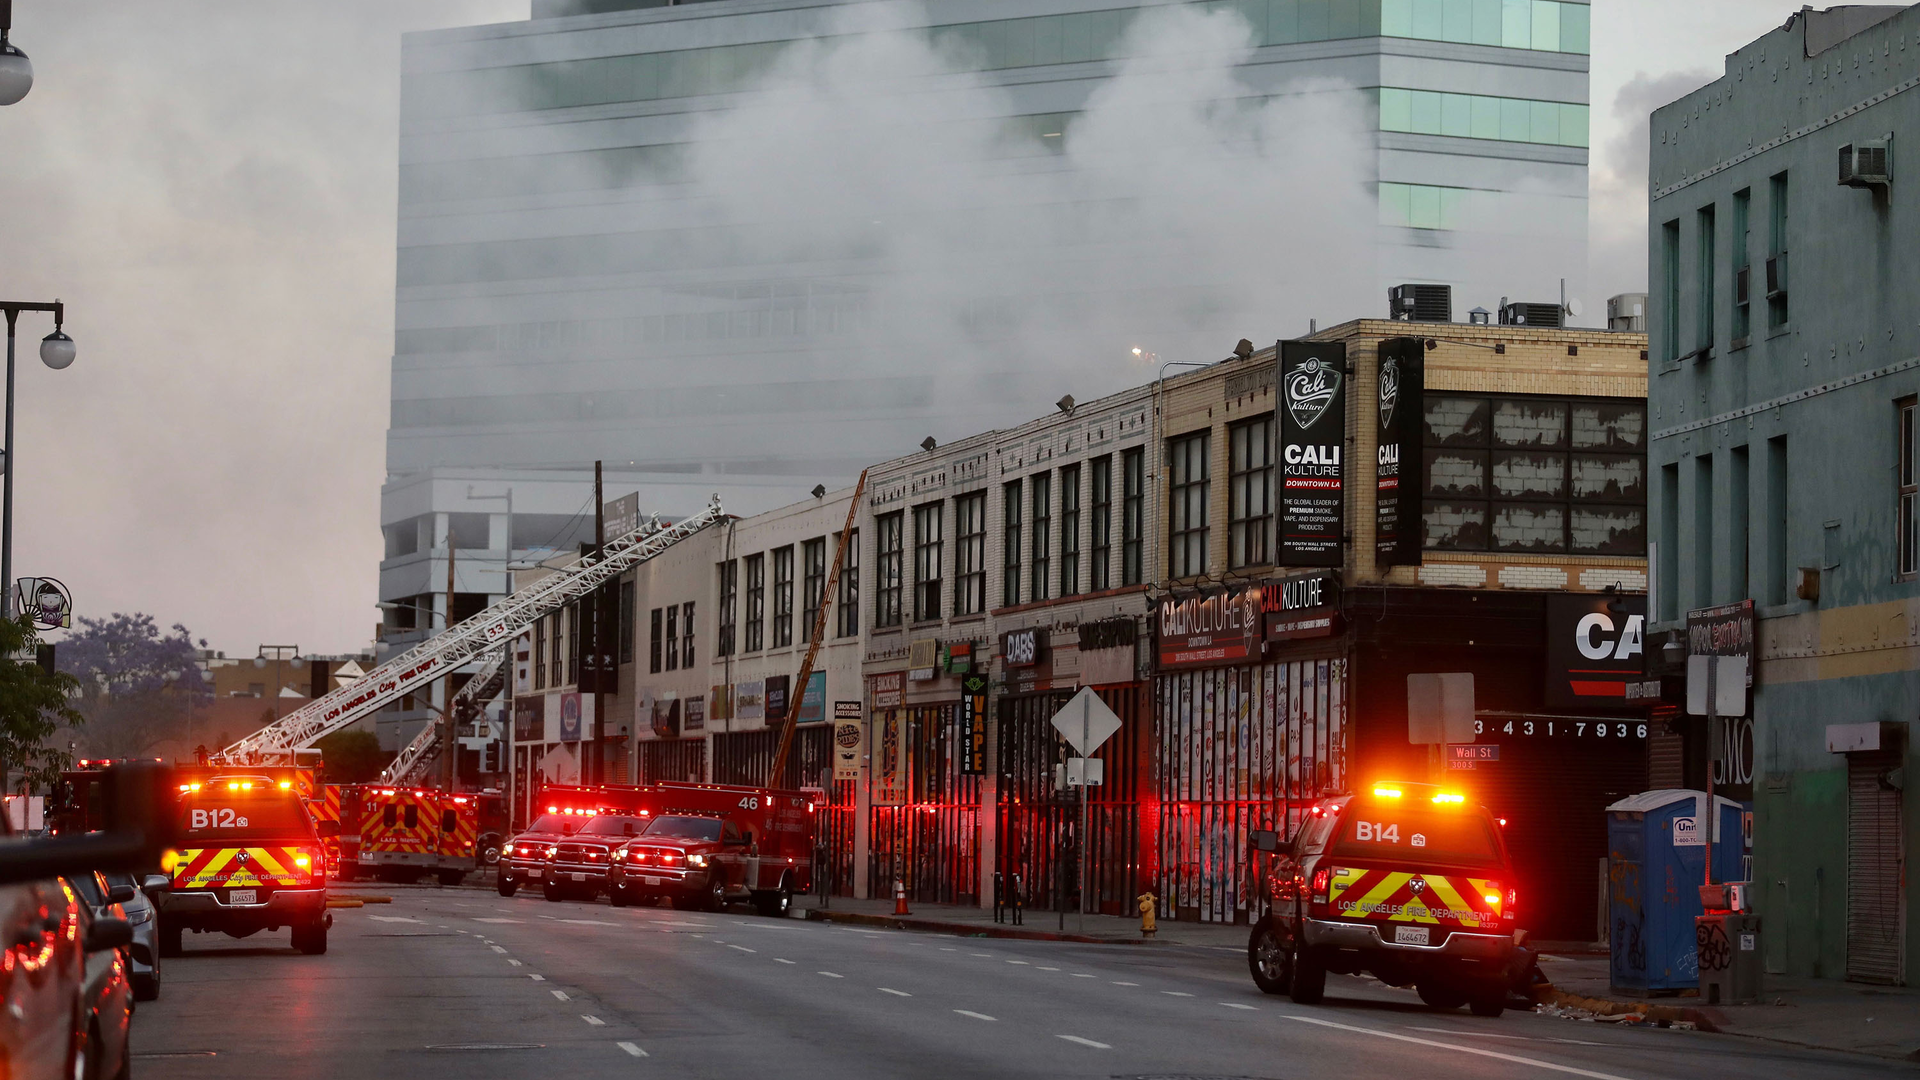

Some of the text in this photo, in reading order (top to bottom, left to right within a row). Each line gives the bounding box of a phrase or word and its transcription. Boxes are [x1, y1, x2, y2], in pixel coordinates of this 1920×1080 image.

[1290, 370, 1326, 400] Cali
[1292, 401, 1323, 411] Kulture
[1284, 444, 1340, 465] CALI
[1378, 443, 1399, 465] CALI
[1284, 465, 1340, 476] KULTURE
[1286, 480, 1341, 488] DOWNTOWN LA
[487, 623, 505, 638] 33
[1006, 630, 1036, 664] DABS
[324, 706, 341, 722] LOS
[341, 689, 376, 713] ANGELES
[378, 680, 398, 694] City
[399, 668, 417, 683] FIRE
[416, 657, 439, 676] DEPT.
[836, 702, 860, 711] SMOKING
[964, 694, 972, 735] WORLD
[973, 694, 985, 771] VAPE
[1456, 747, 1492, 758] Wall St
[366, 801, 377, 812] 11
[738, 797, 758, 810] 46
[191, 808, 236, 828] B12
[1356, 821, 1400, 843] B14
[229, 872, 244, 884] City
[260, 873, 303, 881] DEPARTMENT
[1338, 900, 1492, 922] LOS ANGELES FIRE DEPARTMENT
